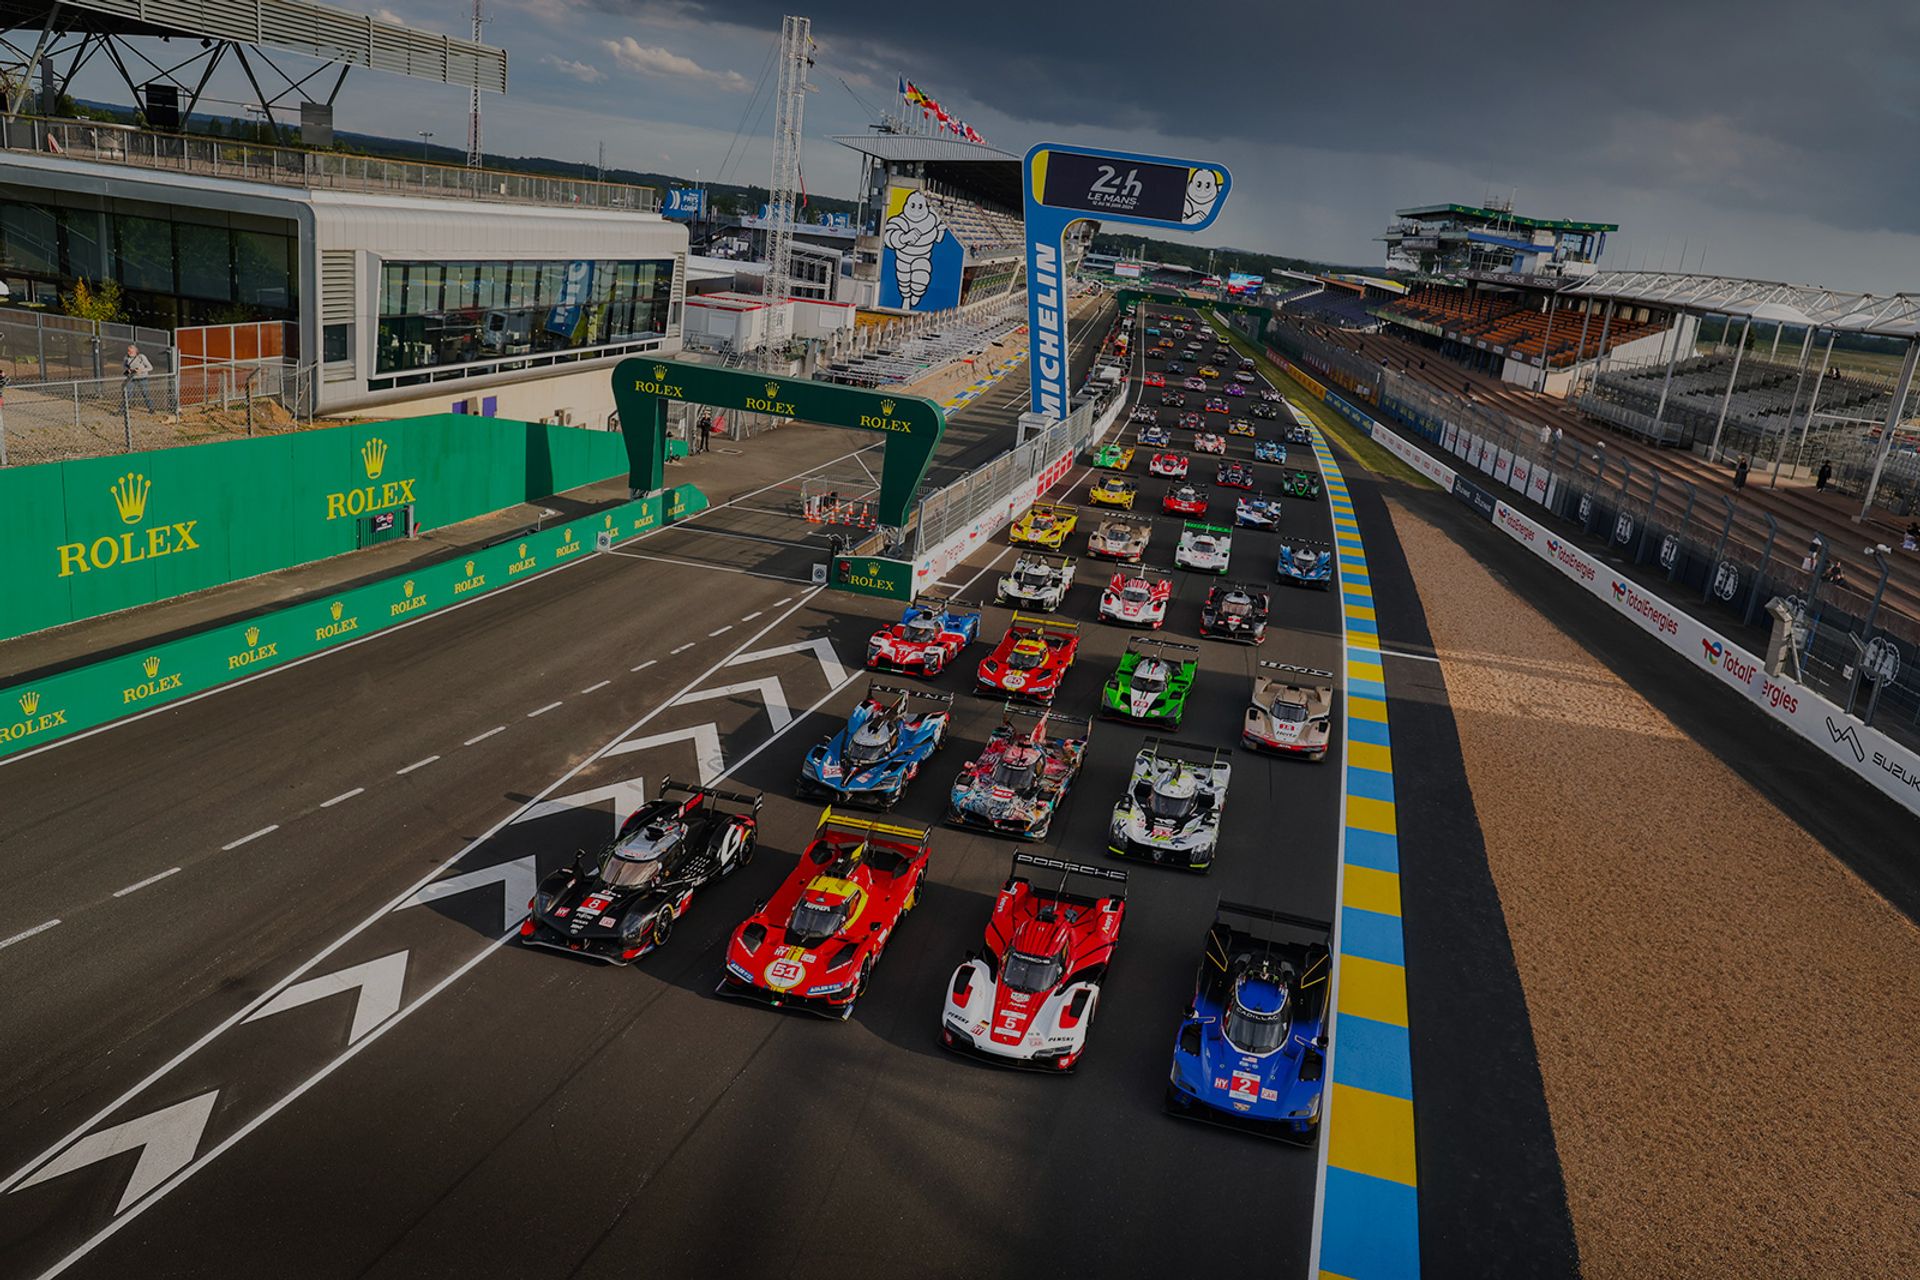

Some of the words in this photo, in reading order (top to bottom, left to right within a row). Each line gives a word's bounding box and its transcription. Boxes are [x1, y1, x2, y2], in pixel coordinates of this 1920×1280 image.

[1090, 165, 1143, 197] 24h
[1088, 192, 1103, 201] LE
[1103, 194, 1138, 205] MANS
[1036, 242, 1061, 422] MICHELIN
[634, 379, 683, 399] ROLEX
[745, 397, 796, 416] ROLEX
[860, 415, 912, 433] ROLEX
[326, 478, 417, 520] ROLEX
[1505, 511, 1536, 542] TotalEnergies
[57, 520, 200, 577] ROLEX
[556, 540, 580, 558] ROLEX
[508, 557, 536, 575] ROLEX
[1555, 545, 1595, 581] TotalEnergies
[454, 575, 485, 594] ROLEX
[851, 574, 894, 592] ROLEX
[390, 594, 426, 616] ROLEX
[1626, 589, 1679, 636] TotalEnergies
[315, 616, 358, 641] ROLEX
[228, 642, 278, 670] ROLEX
[123, 673, 183, 705] ROLEX
[0, 709, 67, 744] ROLEX
[1872, 751, 1920, 792] SUZUK
[1017, 854, 1127, 880] PORSCHE
[588, 898, 601, 909] 8
[773, 963, 798, 978] 51
[1004, 1018, 1017, 1030] 5
[1235, 1007, 1279, 1021] CADILLAC
[1238, 1078, 1252, 1094] 2
